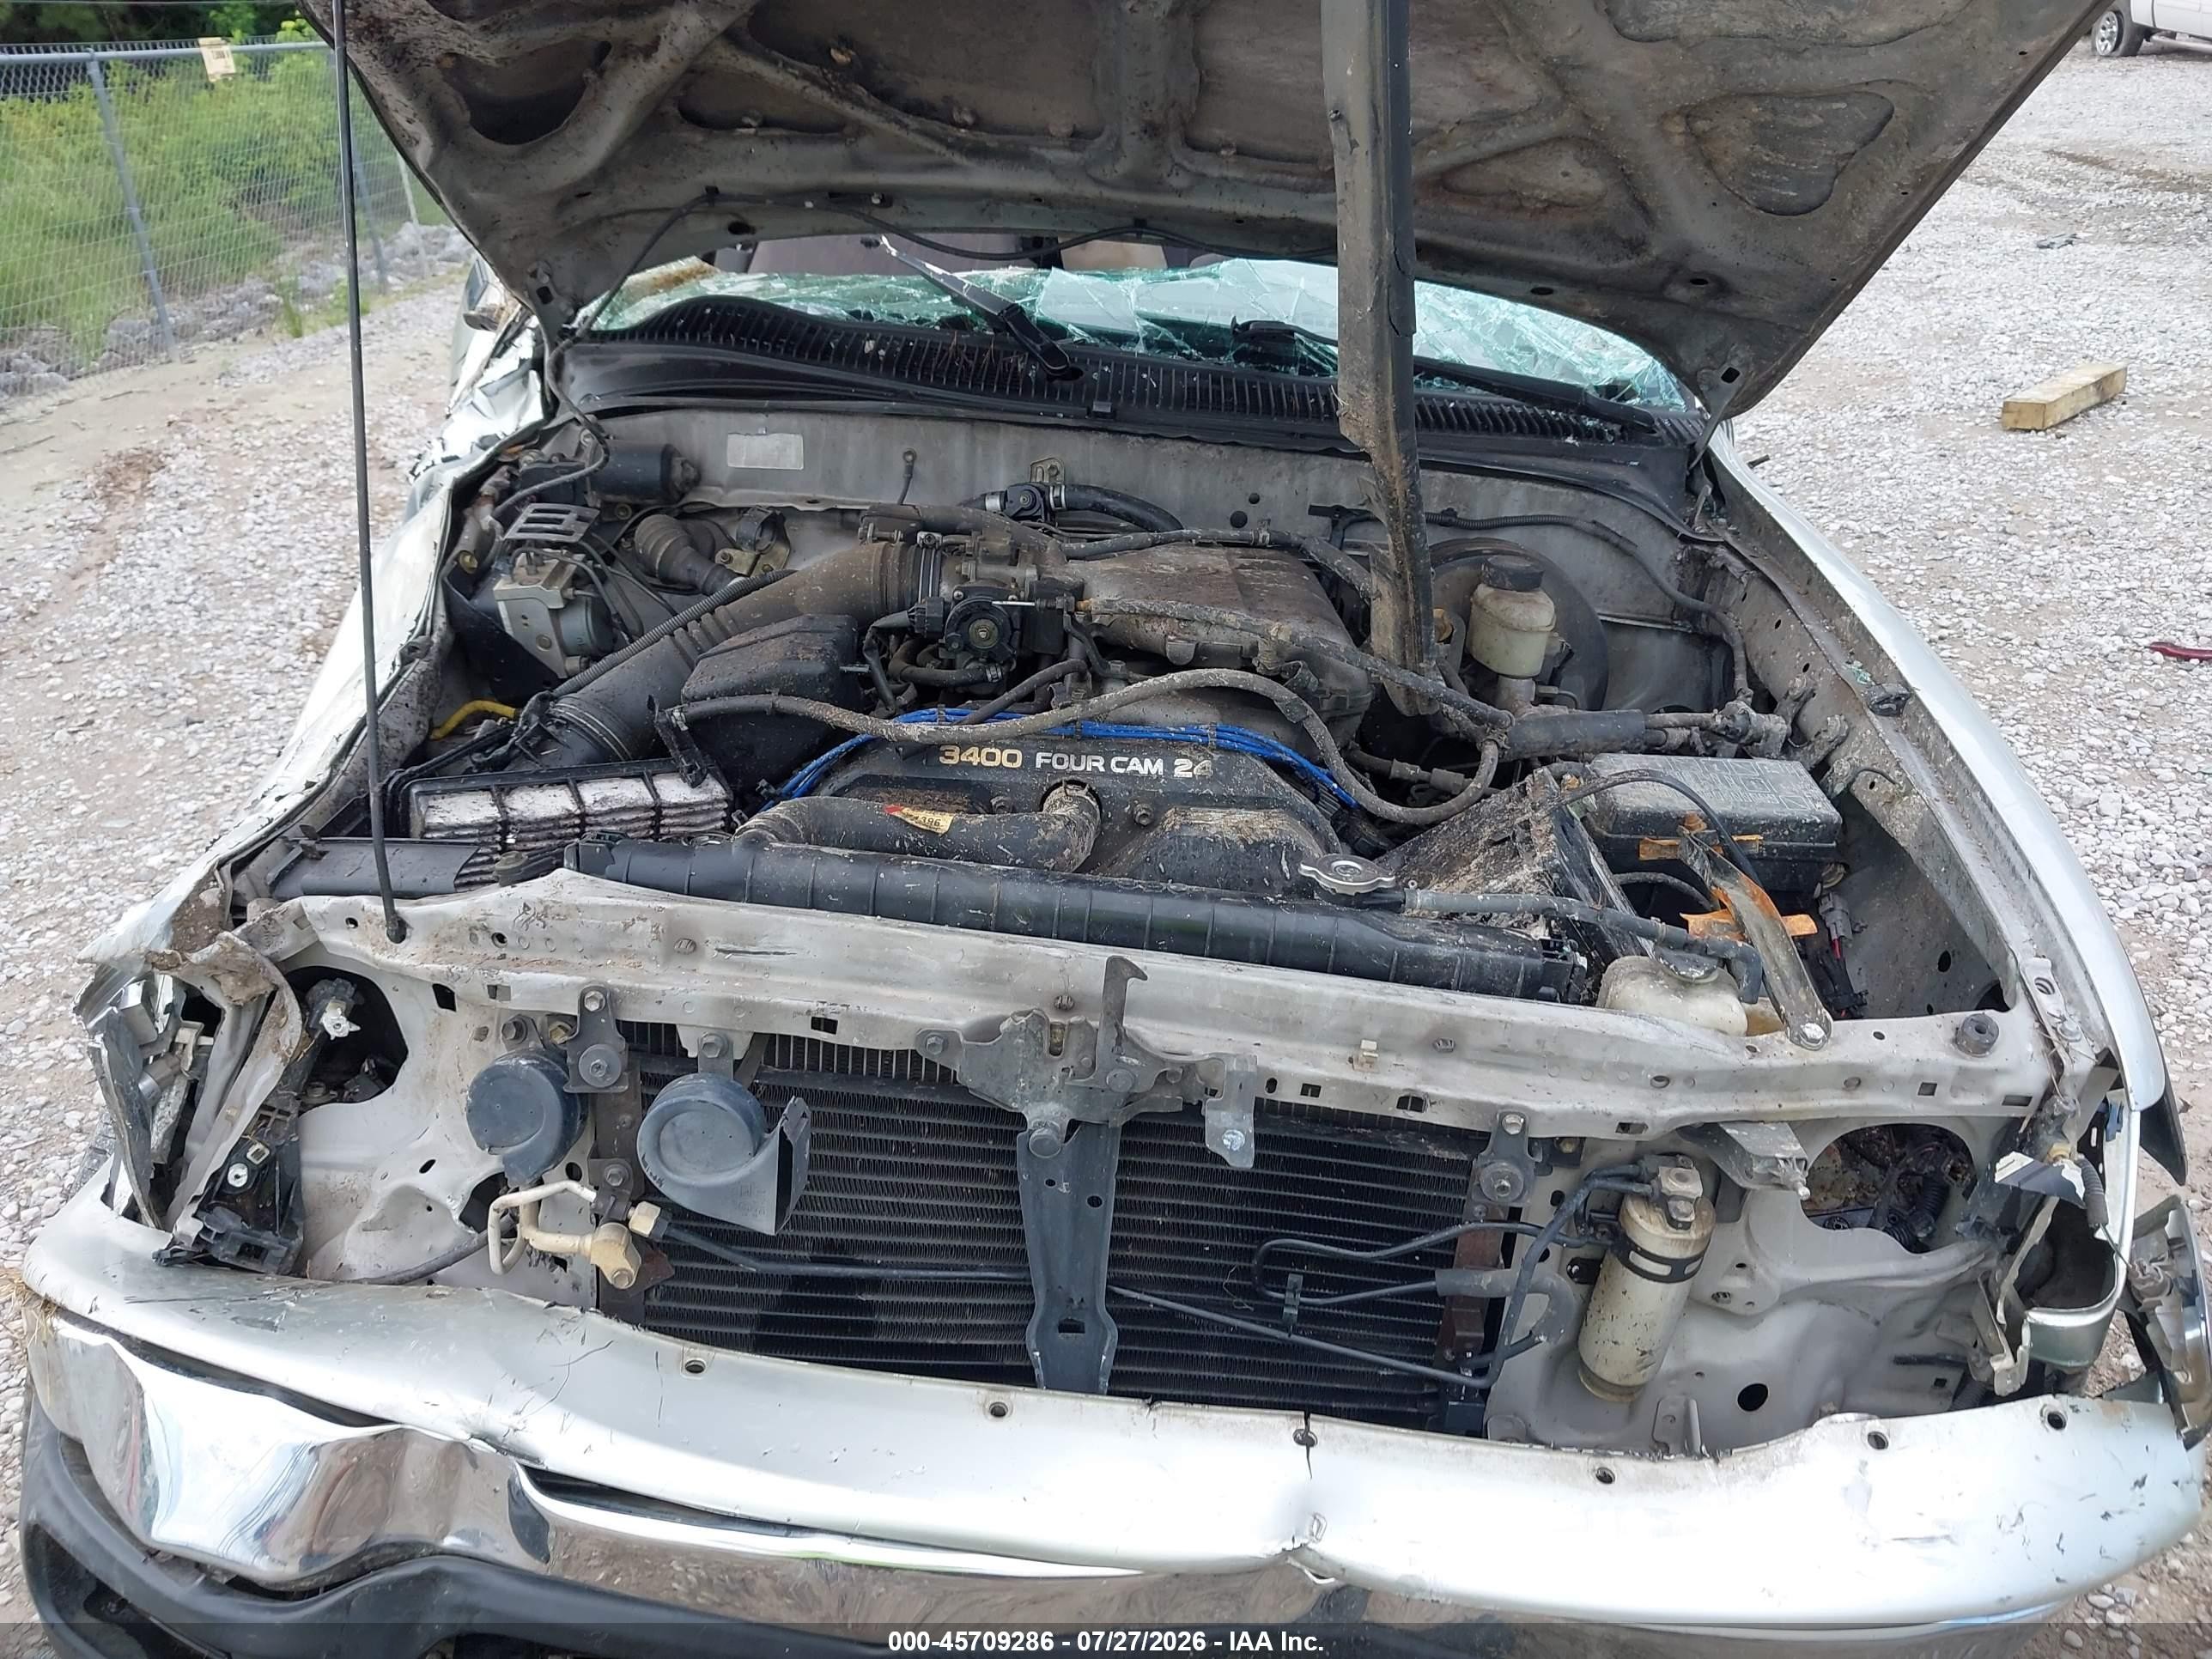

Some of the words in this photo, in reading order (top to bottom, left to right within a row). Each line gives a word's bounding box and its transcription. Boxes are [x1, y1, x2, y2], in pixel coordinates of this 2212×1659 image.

[939, 745, 1023, 769] 3400
[1035, 751, 1105, 773] FOUR
[1110, 757, 1164, 776] CAM
[1173, 758, 1213, 778] 24
